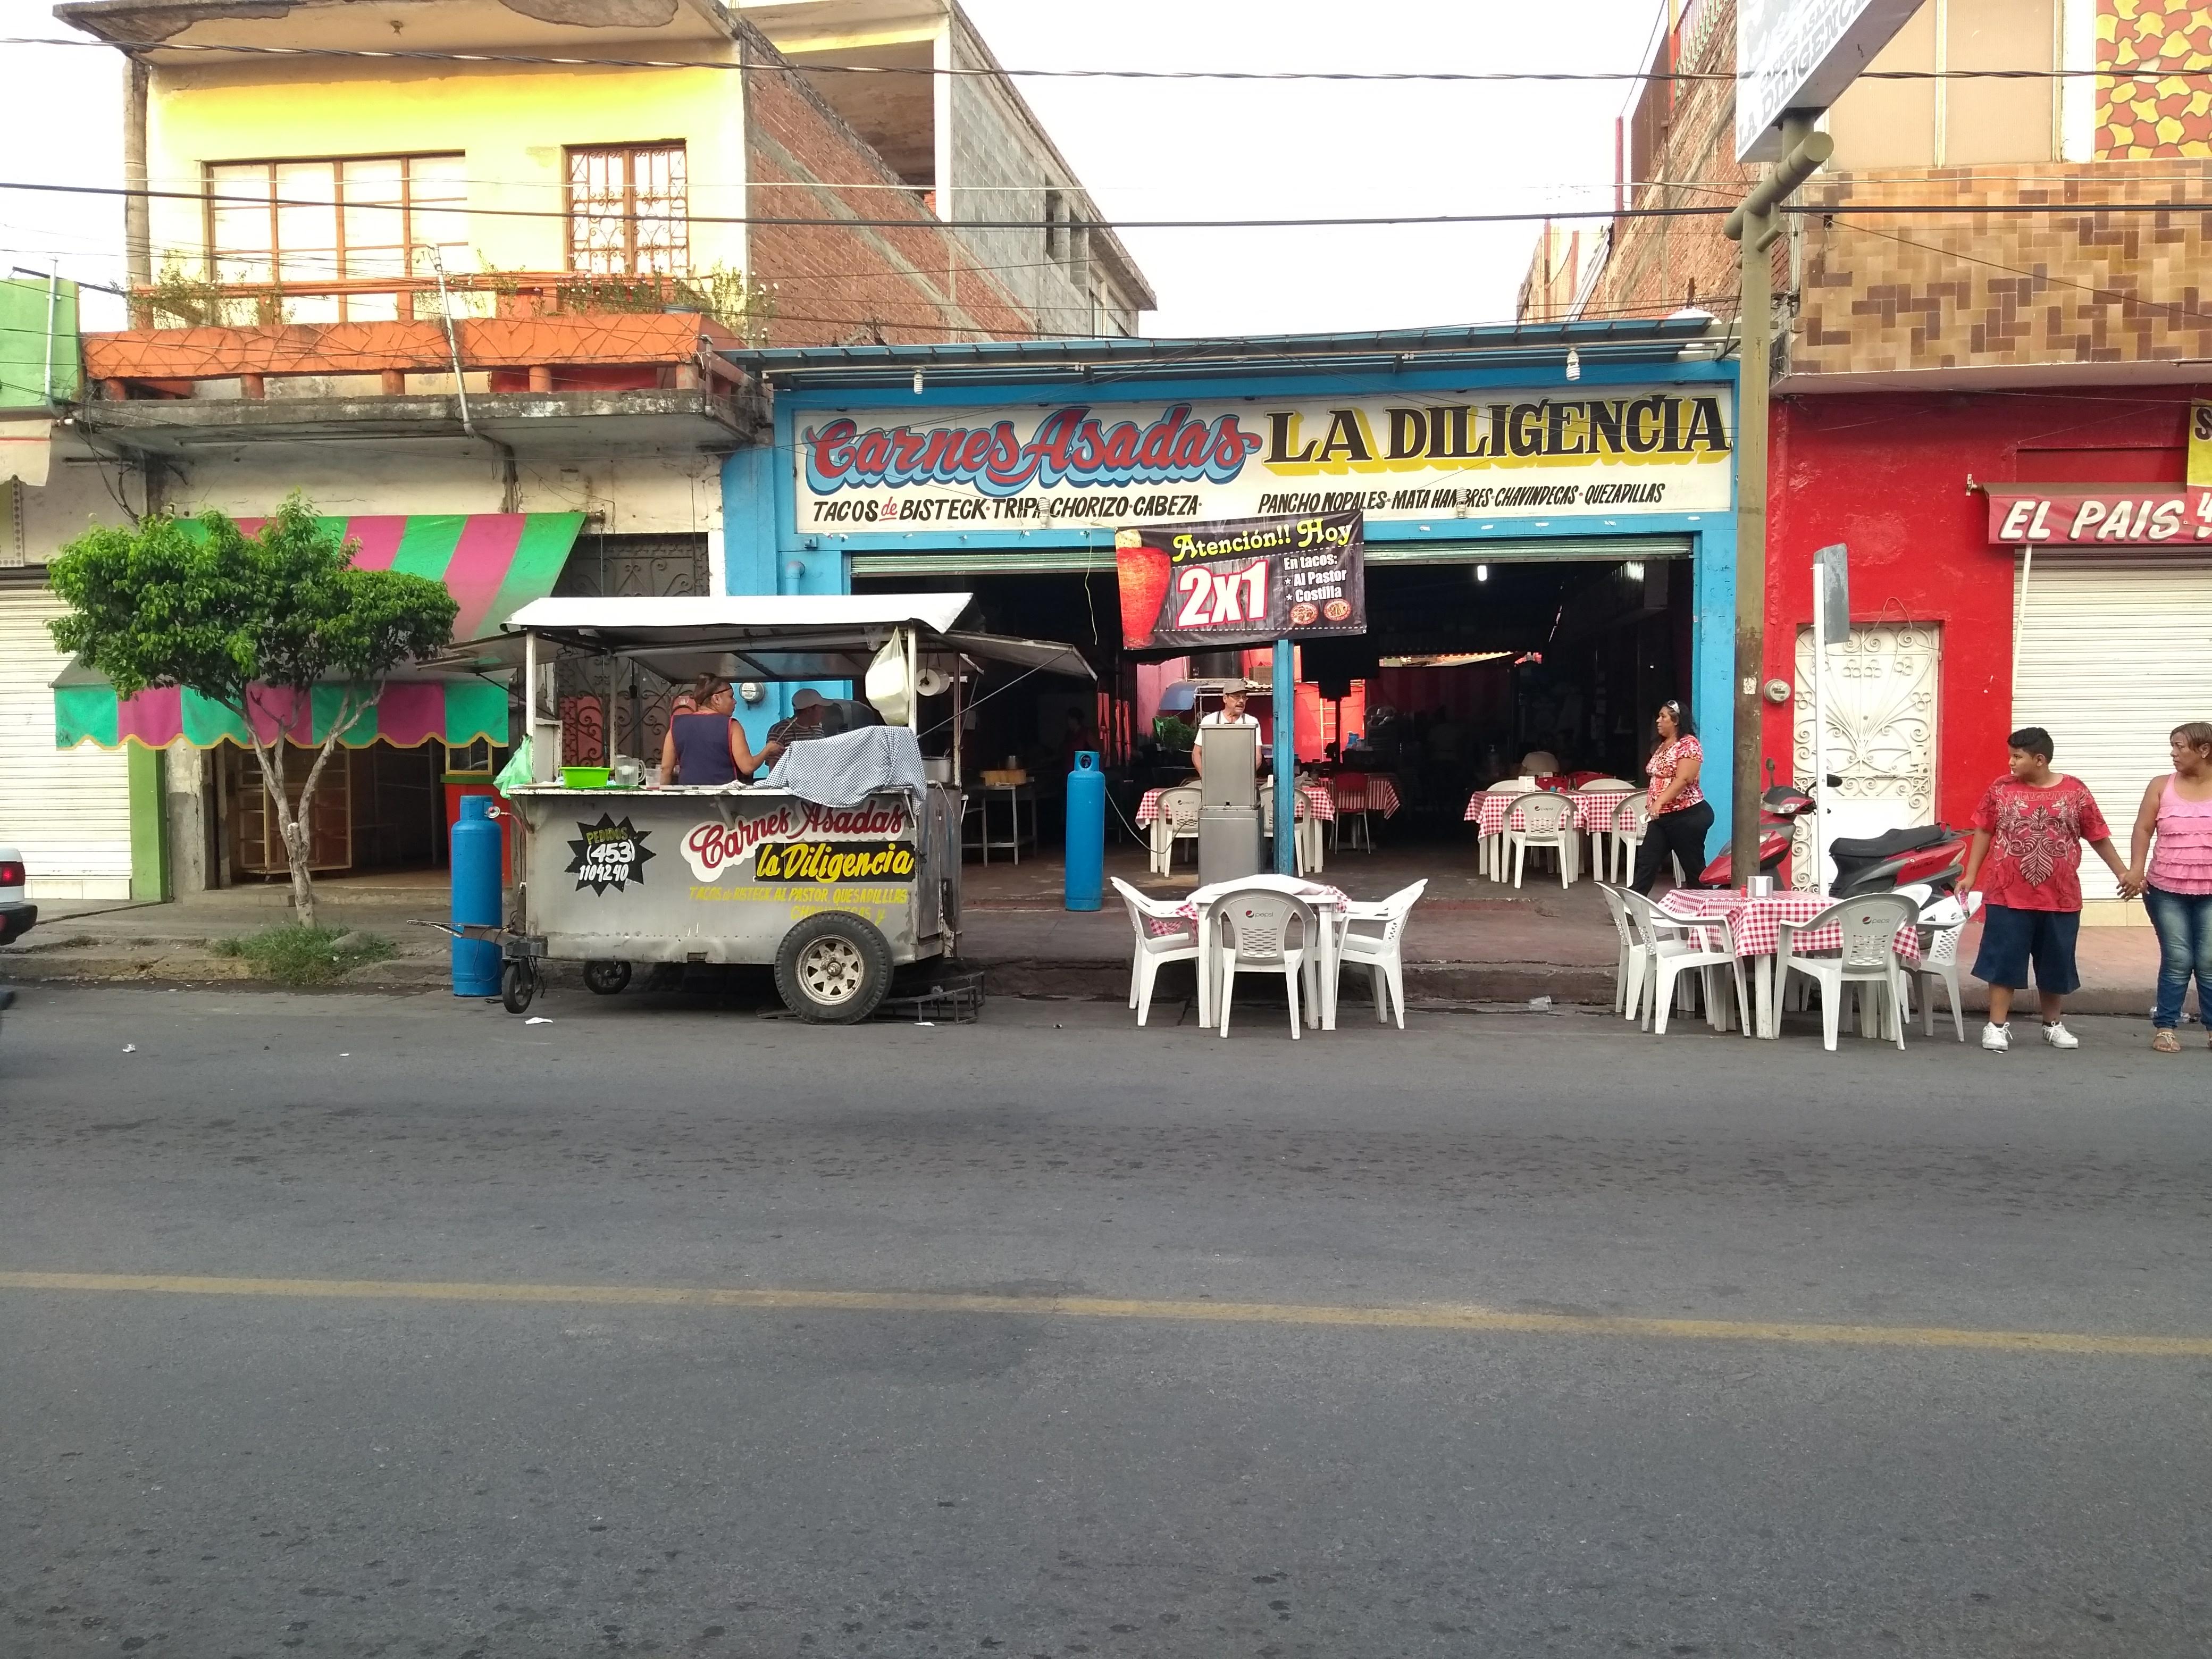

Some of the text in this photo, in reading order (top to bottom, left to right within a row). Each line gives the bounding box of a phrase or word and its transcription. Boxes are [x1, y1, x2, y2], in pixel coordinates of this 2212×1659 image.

[1762, 0, 1865, 125] DILIGENCI
[1263, 394, 1732, 468] LA DILIGENCIA
[803, 404, 1262, 487] Carnes Asadas
[814, 499, 878, 522] TACOS
[879, 496, 897, 522] de
[899, 499, 987, 520] BISTECK
[1050, 496, 1129, 518] CHORIZO
[1133, 495, 1199, 516] CABEZA
[1258, 492, 1321, 513] PANCHO
[1321, 491, 1387, 512] NOPALES
[1391, 489, 1431, 509] MATA
[1585, 483, 1665, 505] QUEZADILLAS
[1999, 500, 2185, 541] EL PAIS
[1172, 518, 1352, 562] Atención!! Hoy
[1283, 554, 1338, 571] En tacos:
[1294, 568, 1347, 586] Al Pastor
[1295, 585, 1342, 603] Costilla
[586, 827, 628, 845] PEDIDOS
[689, 800, 907, 869] Carnes Asadas
[586, 839, 635, 865] (453)
[781, 843, 915, 883] Diligencia
[579, 864, 629, 882] 1104240
[690, 886, 722, 901] TACOS
